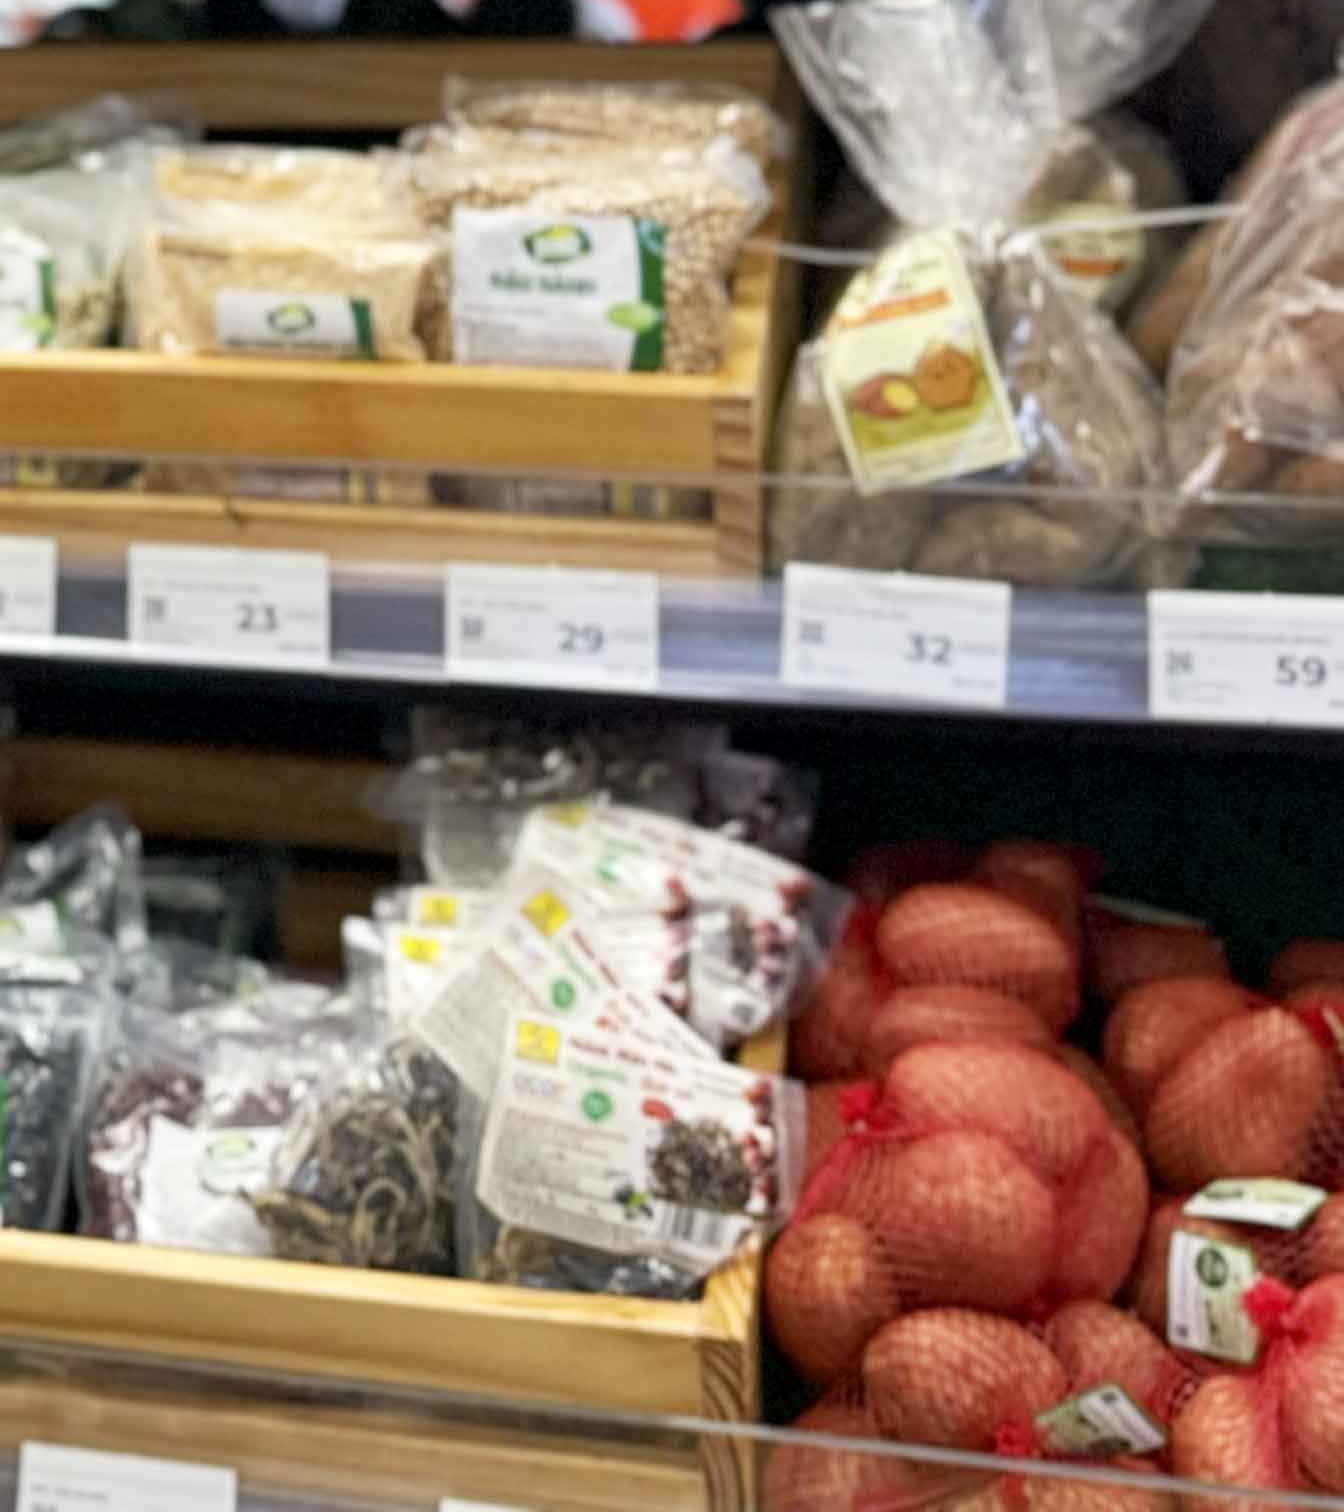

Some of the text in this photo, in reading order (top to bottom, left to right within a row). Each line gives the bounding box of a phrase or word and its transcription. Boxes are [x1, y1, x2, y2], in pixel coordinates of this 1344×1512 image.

[233, 600, 279, 635] 23
[557, 619, 606, 657] 29
[902, 629, 954, 666] 32
[1273, 652, 1328, 689] 59
